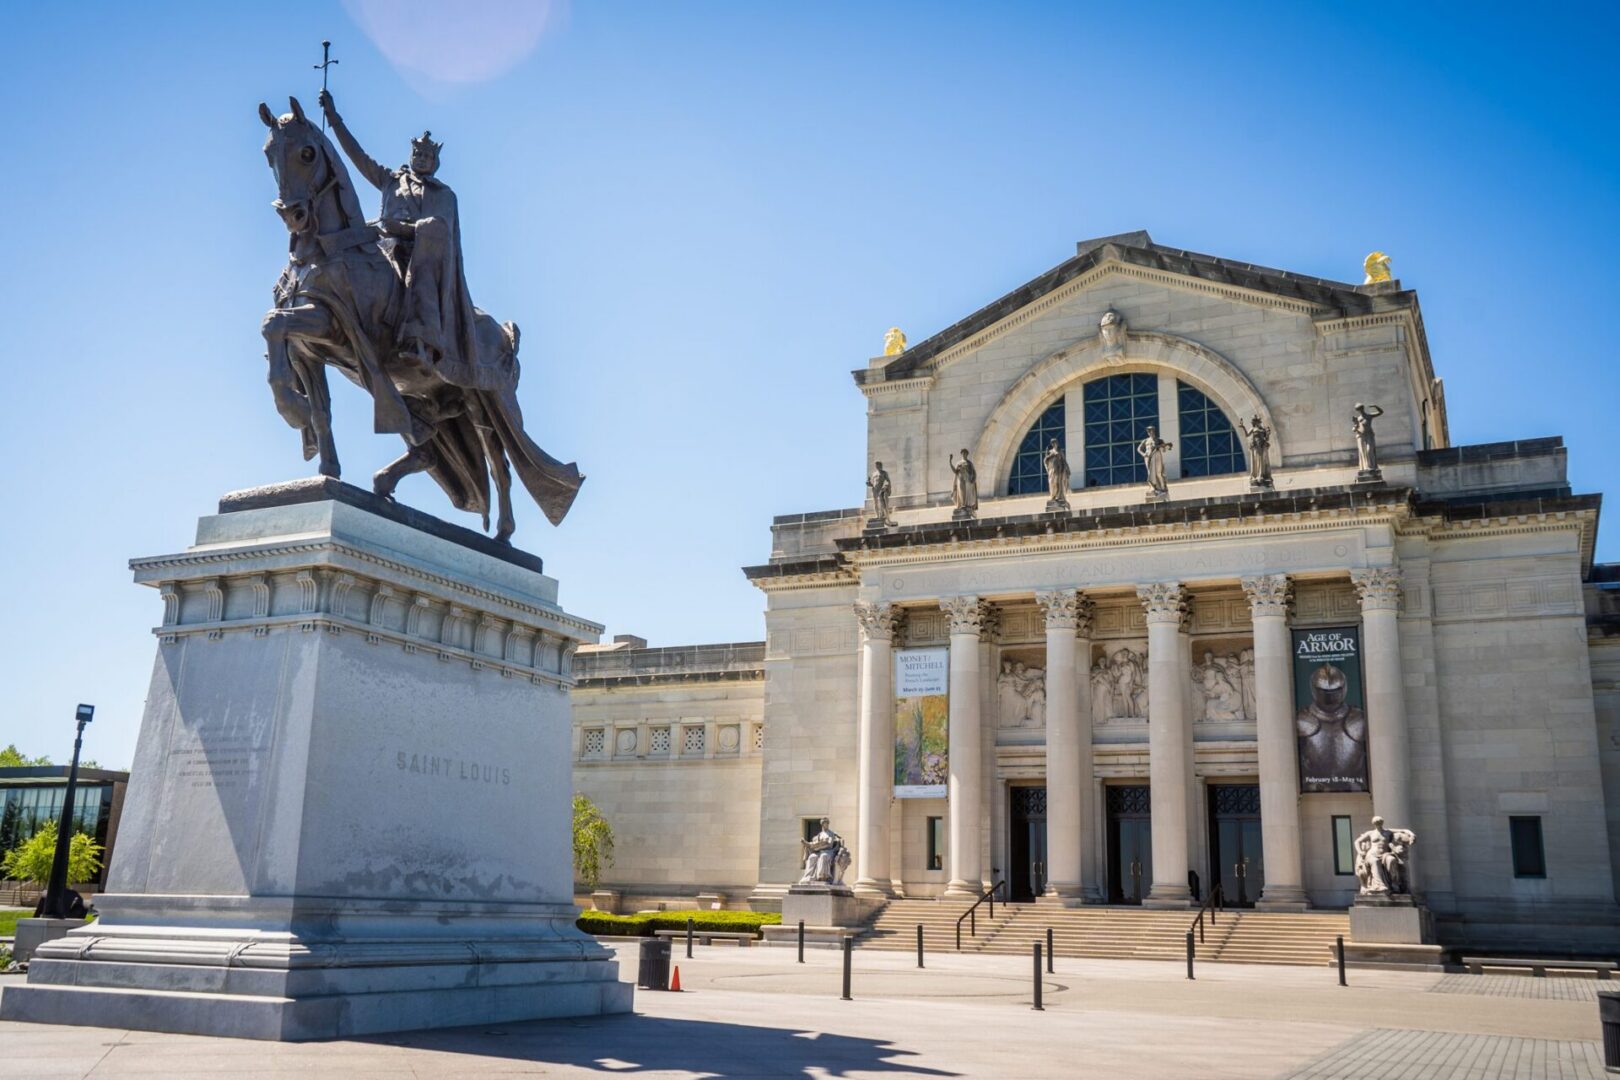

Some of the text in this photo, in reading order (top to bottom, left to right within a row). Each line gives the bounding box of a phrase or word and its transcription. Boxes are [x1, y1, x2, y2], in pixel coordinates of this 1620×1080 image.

[1307, 633, 1342, 642] AGE OF
[1297, 638, 1356, 653] ARMOR
[396, 751, 511, 786] SAINT LOUIS
